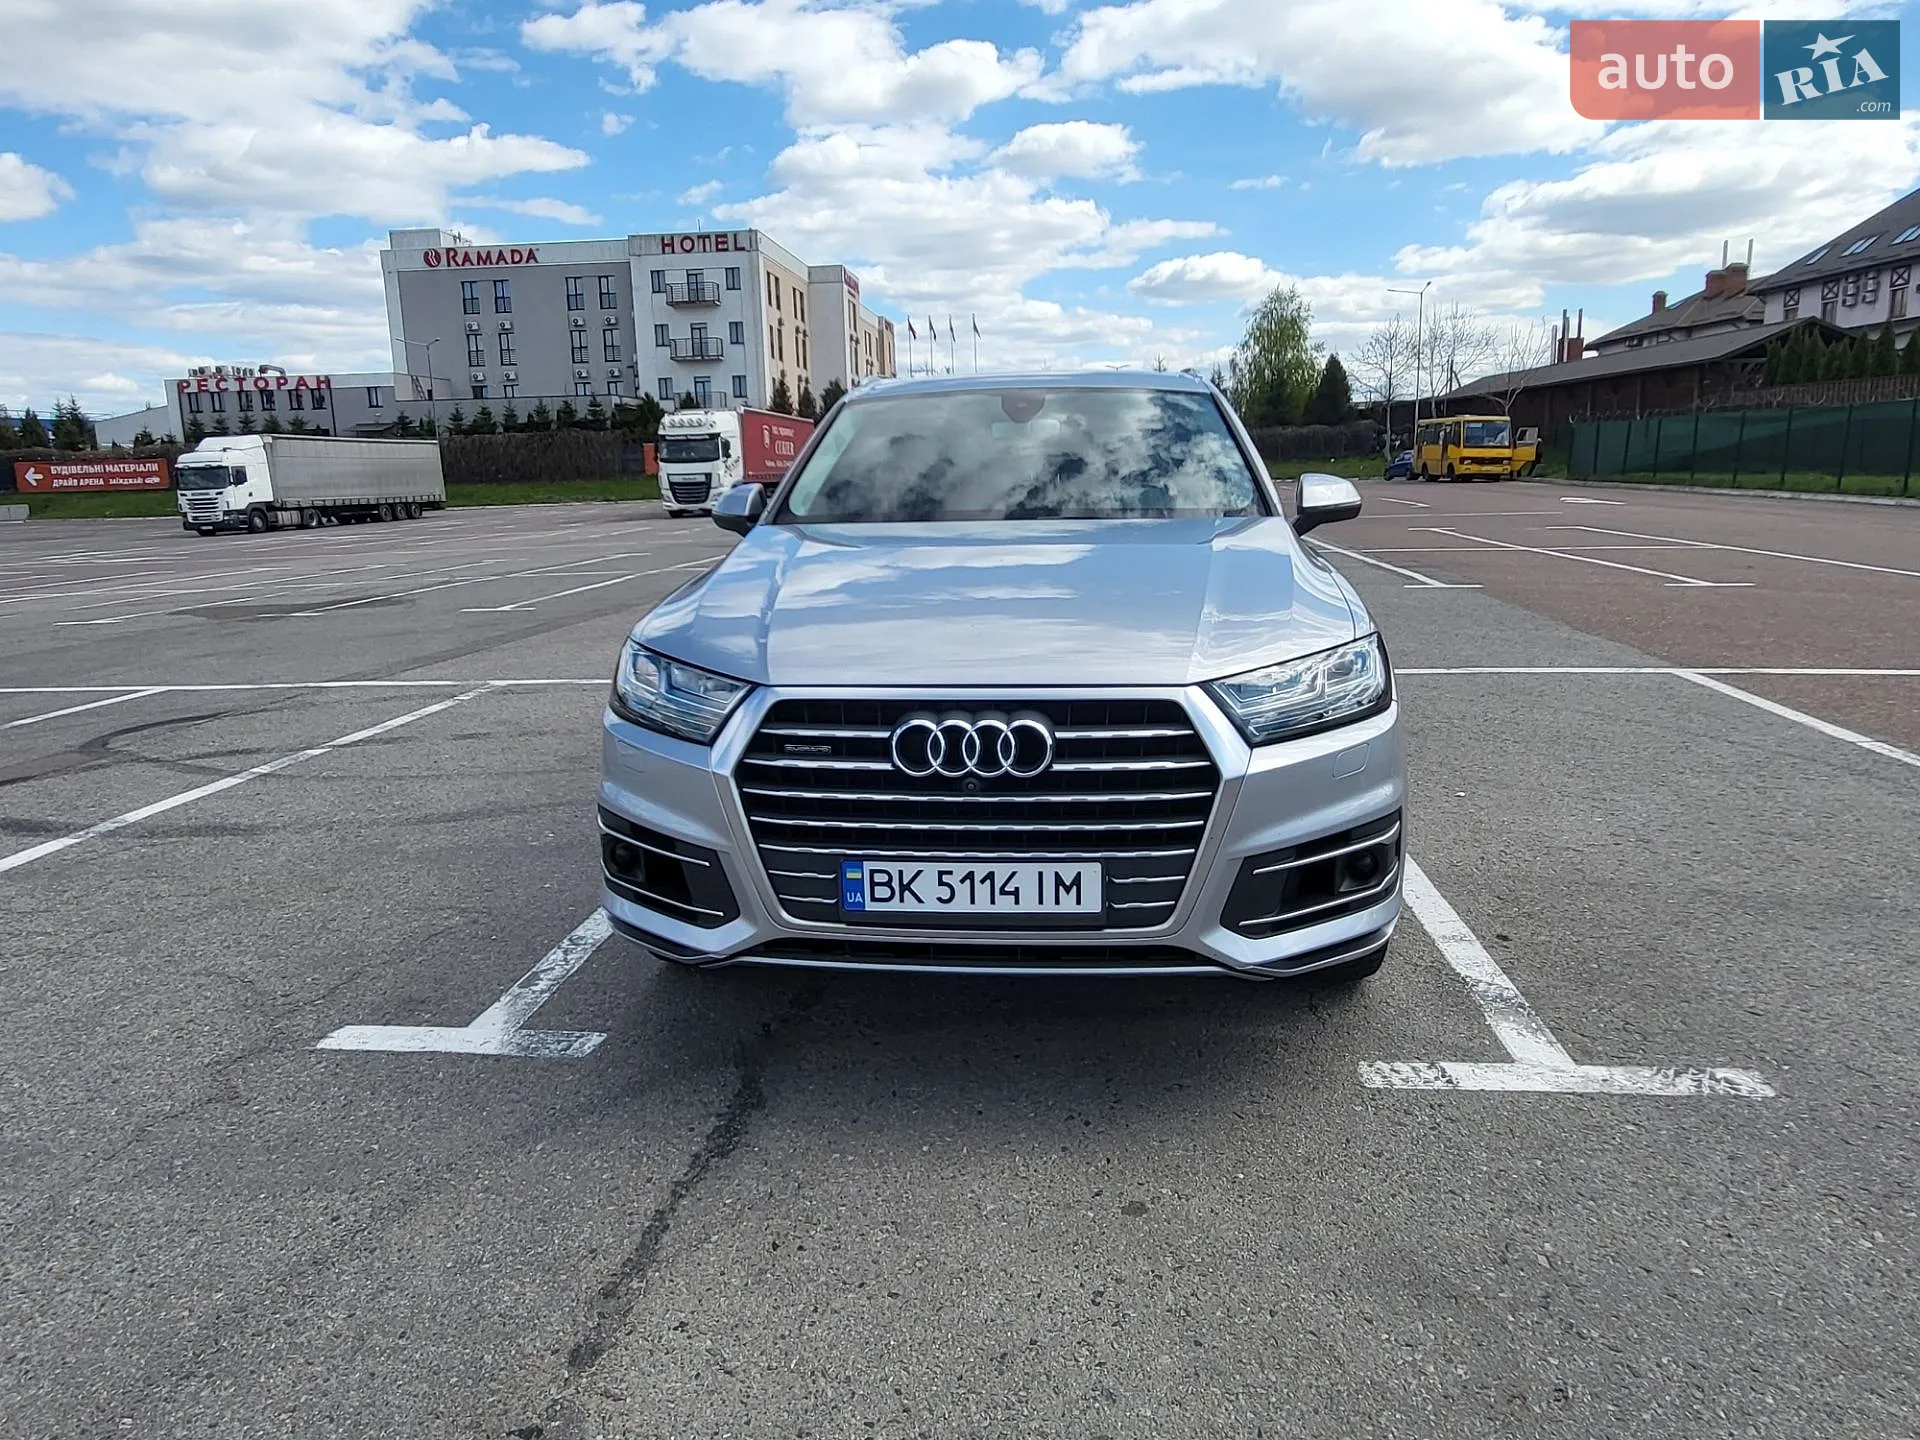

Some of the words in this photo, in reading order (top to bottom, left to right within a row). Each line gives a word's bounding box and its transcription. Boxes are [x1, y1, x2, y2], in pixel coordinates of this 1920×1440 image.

[661, 233, 746, 254] HOTEL
[446, 248, 539, 267] RAMADA
[177, 375, 331, 393] РЕСТОРАН
[50, 464, 104, 475] БУДІВЕЛЬНІ
[105, 463, 159, 473] МАТЕРІАЛИ
[79, 478, 105, 486] АРЕНА
[847, 892, 863, 904] UA
[868, 868, 924, 904] BK
[936, 870, 1020, 905] 5114
[1038, 871, 1082, 905] IM
